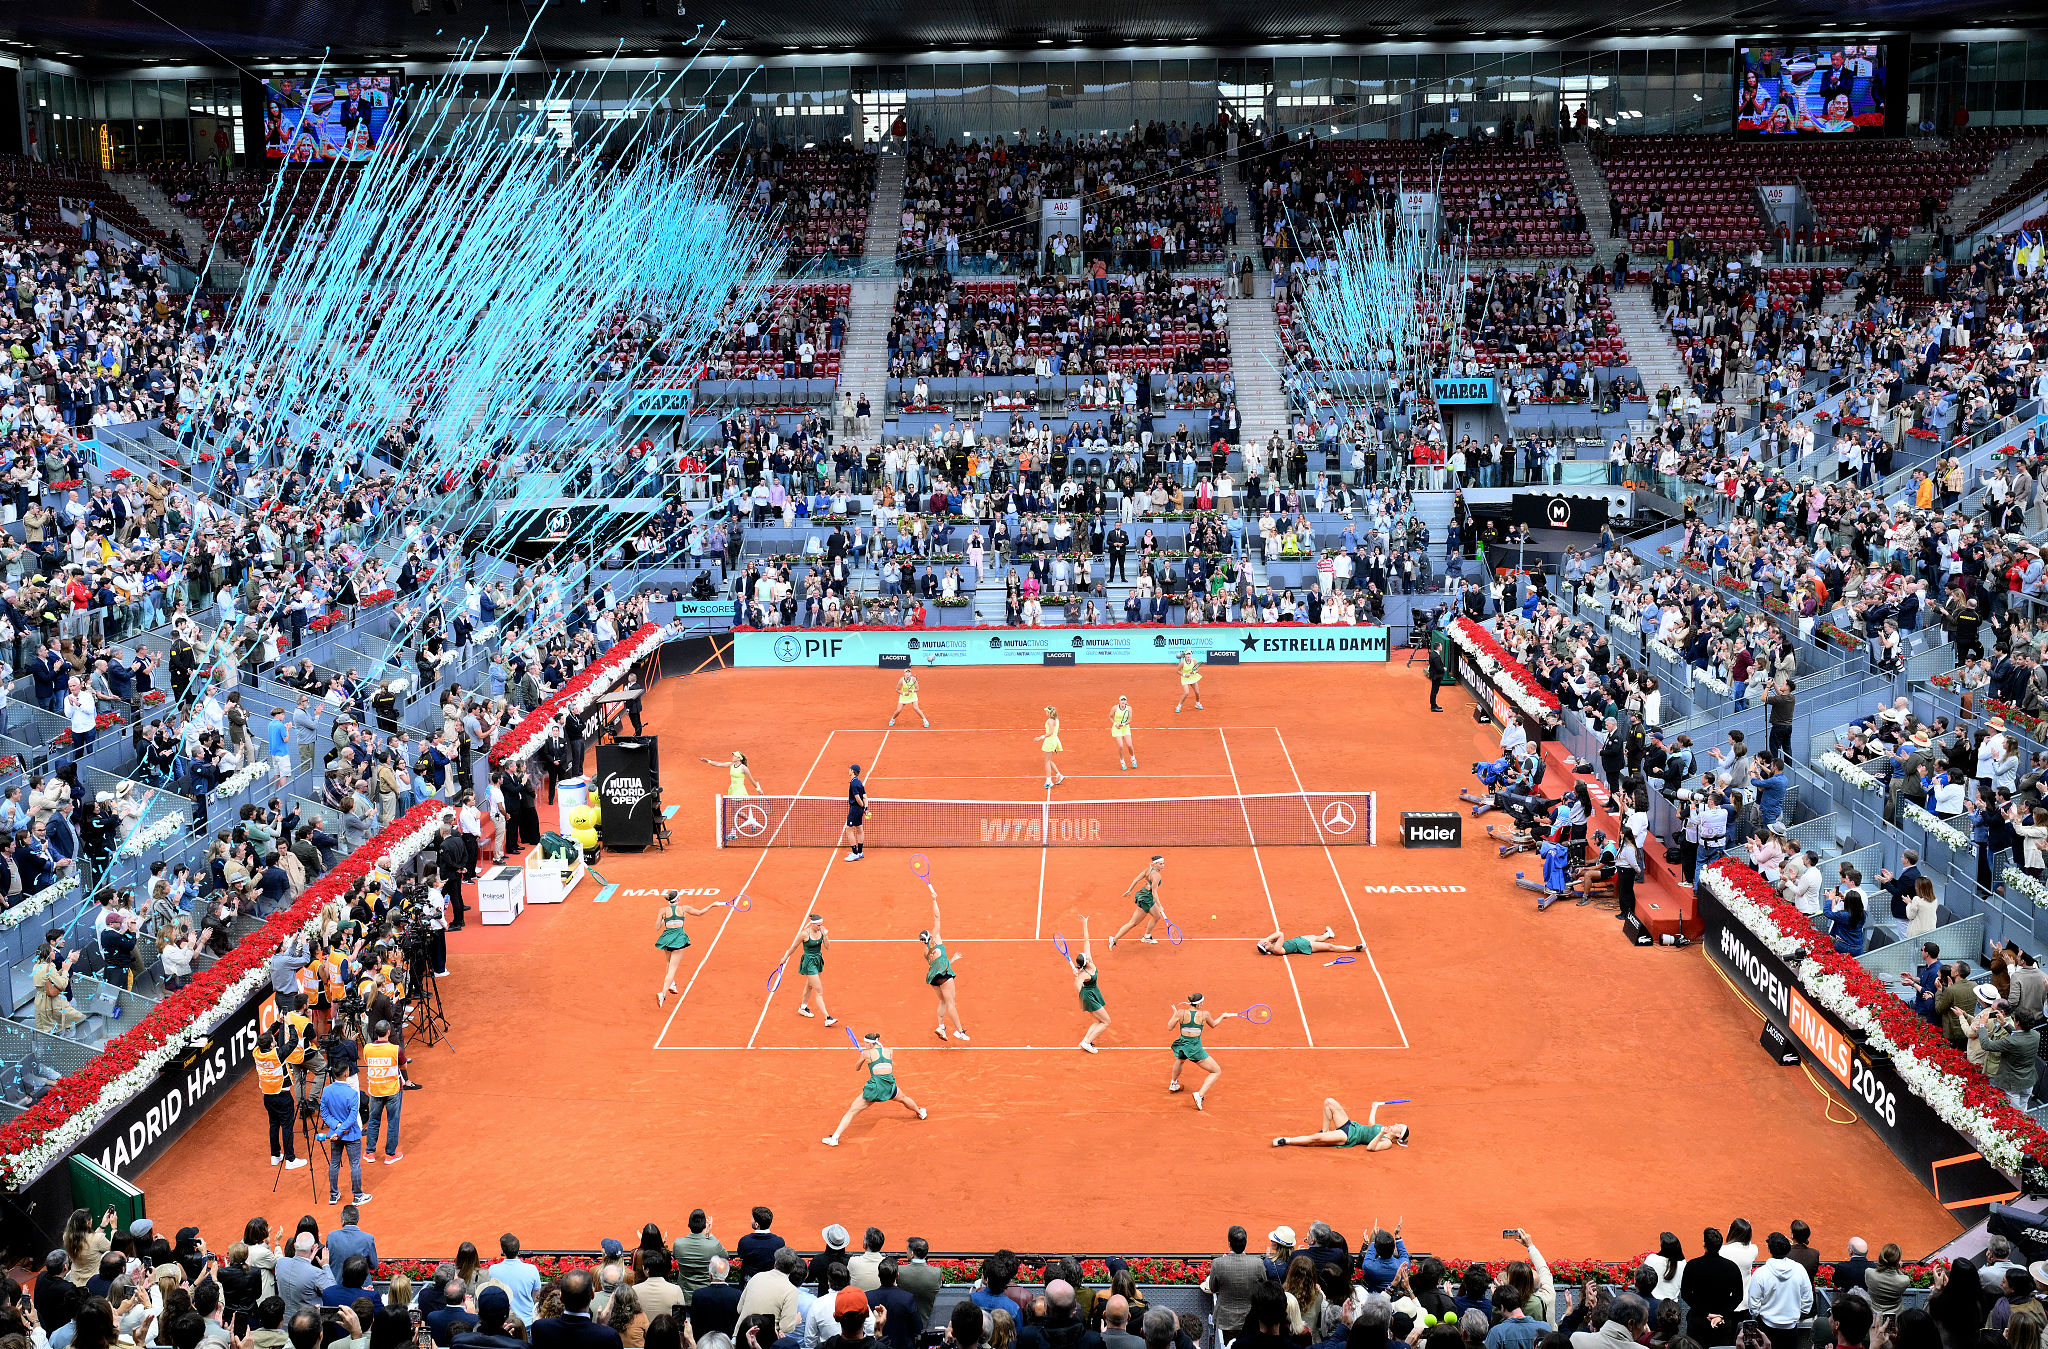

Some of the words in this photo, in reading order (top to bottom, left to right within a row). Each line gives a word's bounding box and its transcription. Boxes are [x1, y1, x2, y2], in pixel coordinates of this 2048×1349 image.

[1053, 202, 1069, 211] A03
[1434, 383, 1488, 399] MARCA
[638, 394, 688, 410] MARCA
[1554, 506, 1564, 519] M
[805, 639, 843, 658] PIF
[1264, 638, 1336, 652] ESTRELLA
[1340, 638, 1386, 651] DAMM
[610, 778, 642, 788] MUTUA
[606, 788, 646, 796] MADRID
[611, 796, 640, 805] OPEN
[980, 818, 1041, 842] WTA
[1049, 818, 1100, 841] TOUR
[1410, 825, 1456, 841] Haier
[1720, 926, 1788, 1016] #MMOPEN
[1790, 994, 1849, 1078] FINALS
[1852, 1058, 1896, 1128] 2026
[1766, 1022, 1785, 1046] LACOSTE
[92, 1088, 182, 1176] MADRID
[187, 1047, 226, 1106] HAS
[230, 1018, 258, 1066] ITS
